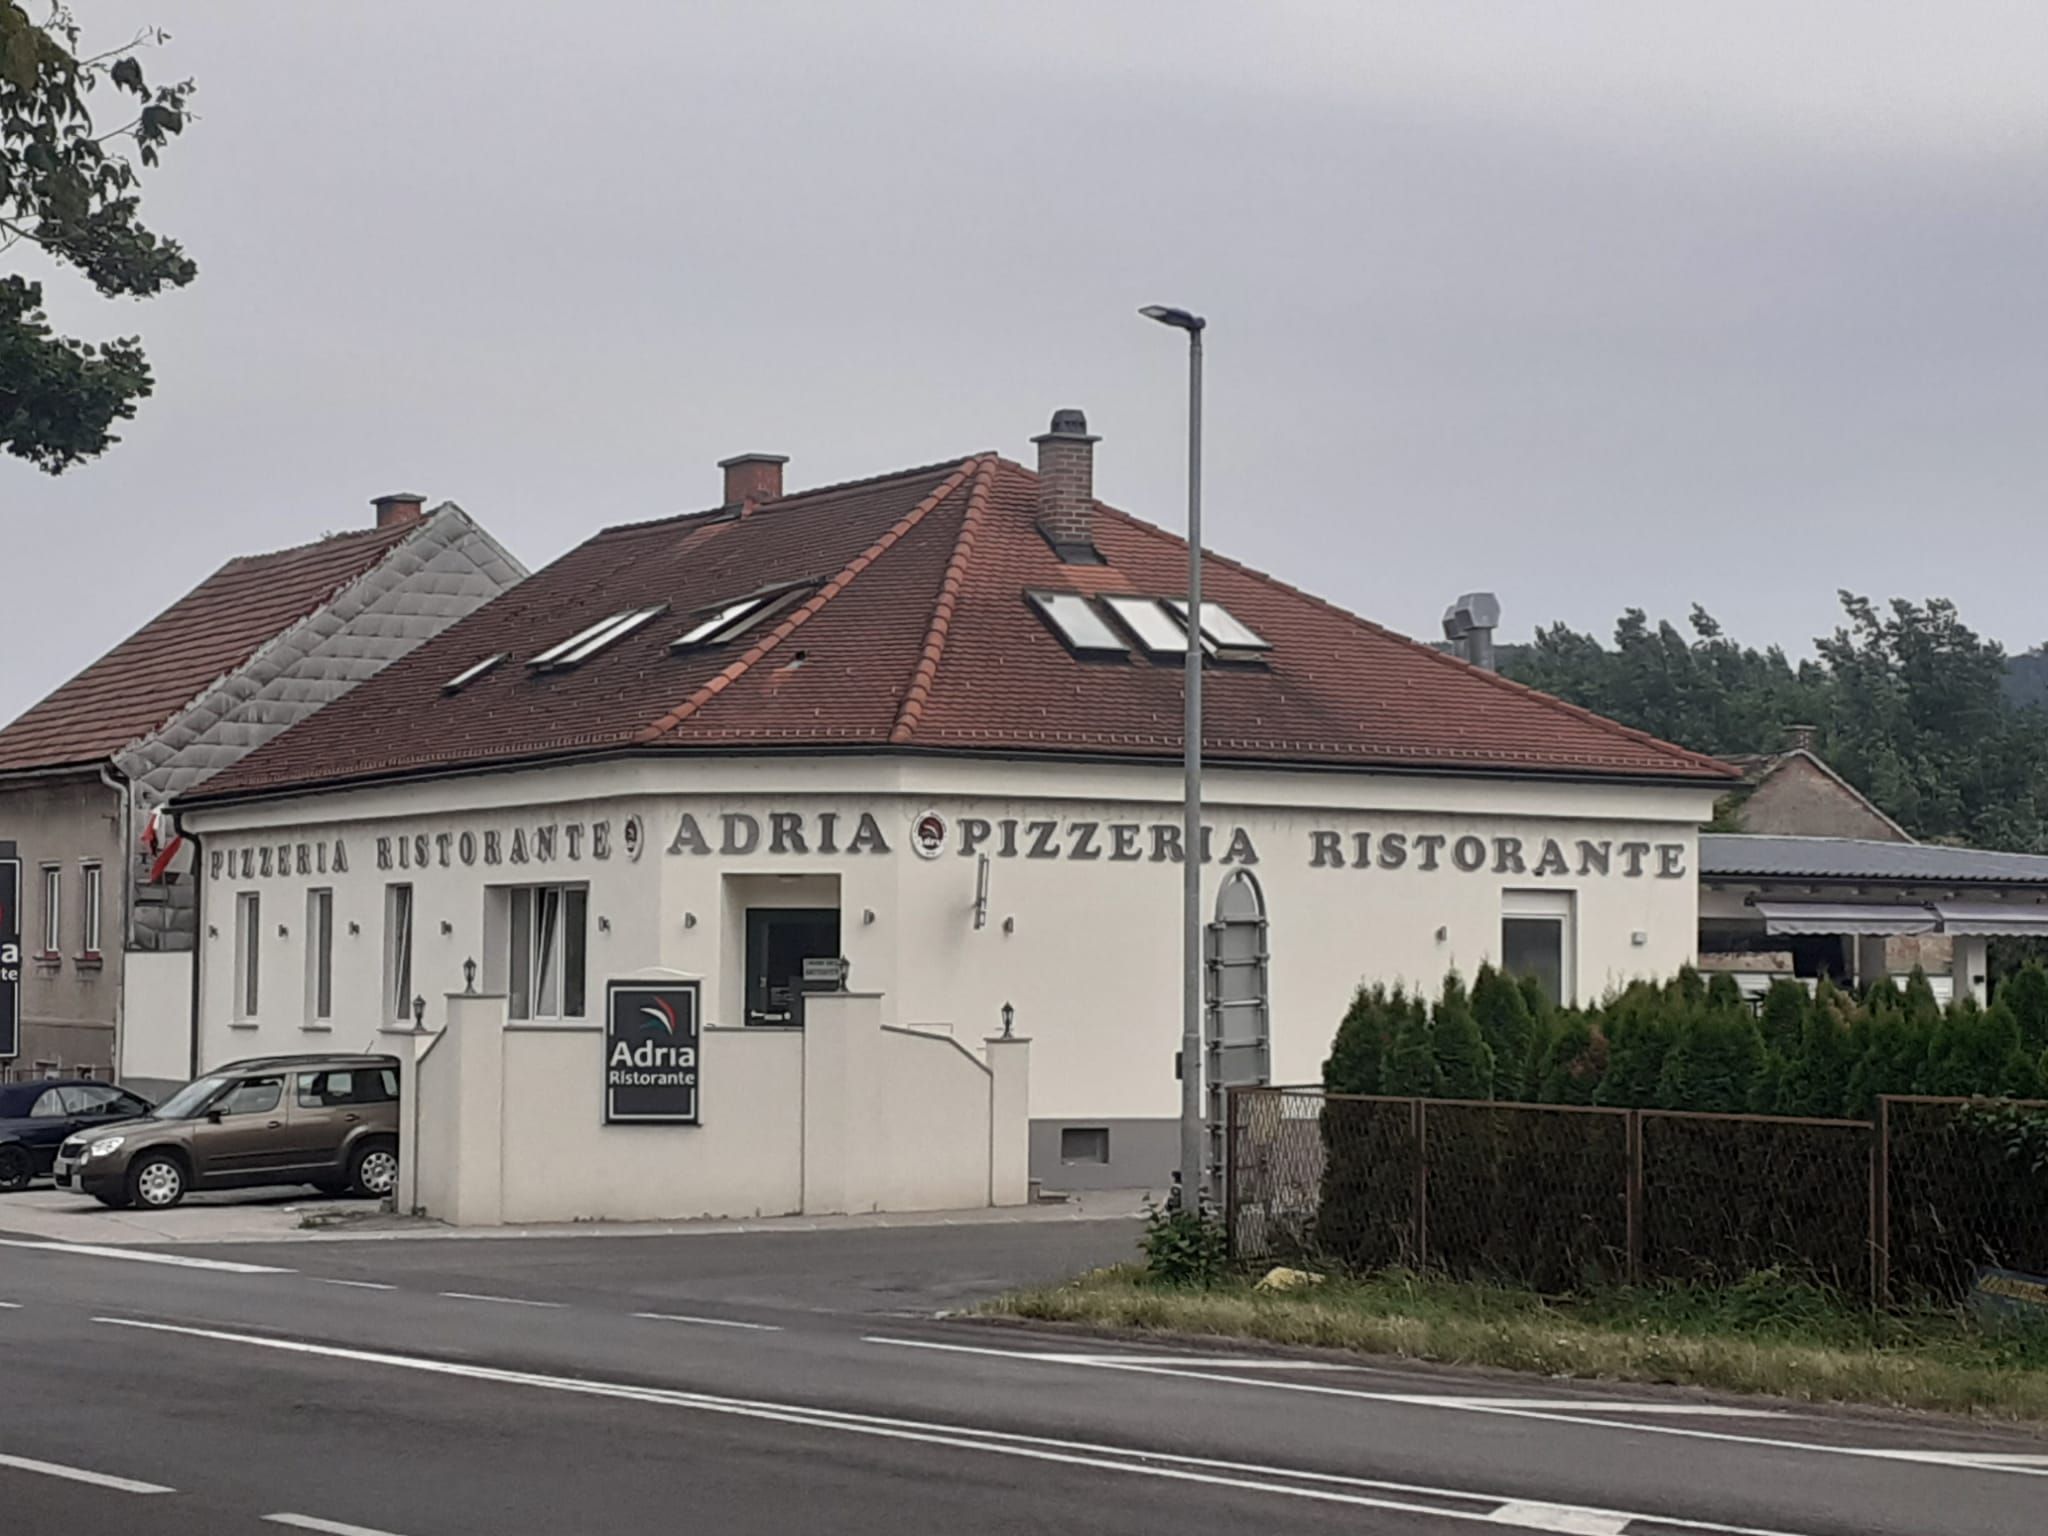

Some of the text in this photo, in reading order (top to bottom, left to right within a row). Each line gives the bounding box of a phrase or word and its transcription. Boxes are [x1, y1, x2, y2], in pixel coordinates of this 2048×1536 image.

[210, 821, 611, 880] PIZZERIA RISTORANTE
[666, 812, 890, 857] ADRIA
[957, 818, 1260, 864] PIZZERIA
[1308, 830, 1687, 879] RISTORANTE
[609, 1039, 696, 1068] Adria
[609, 1070, 696, 1086] Ristorante
